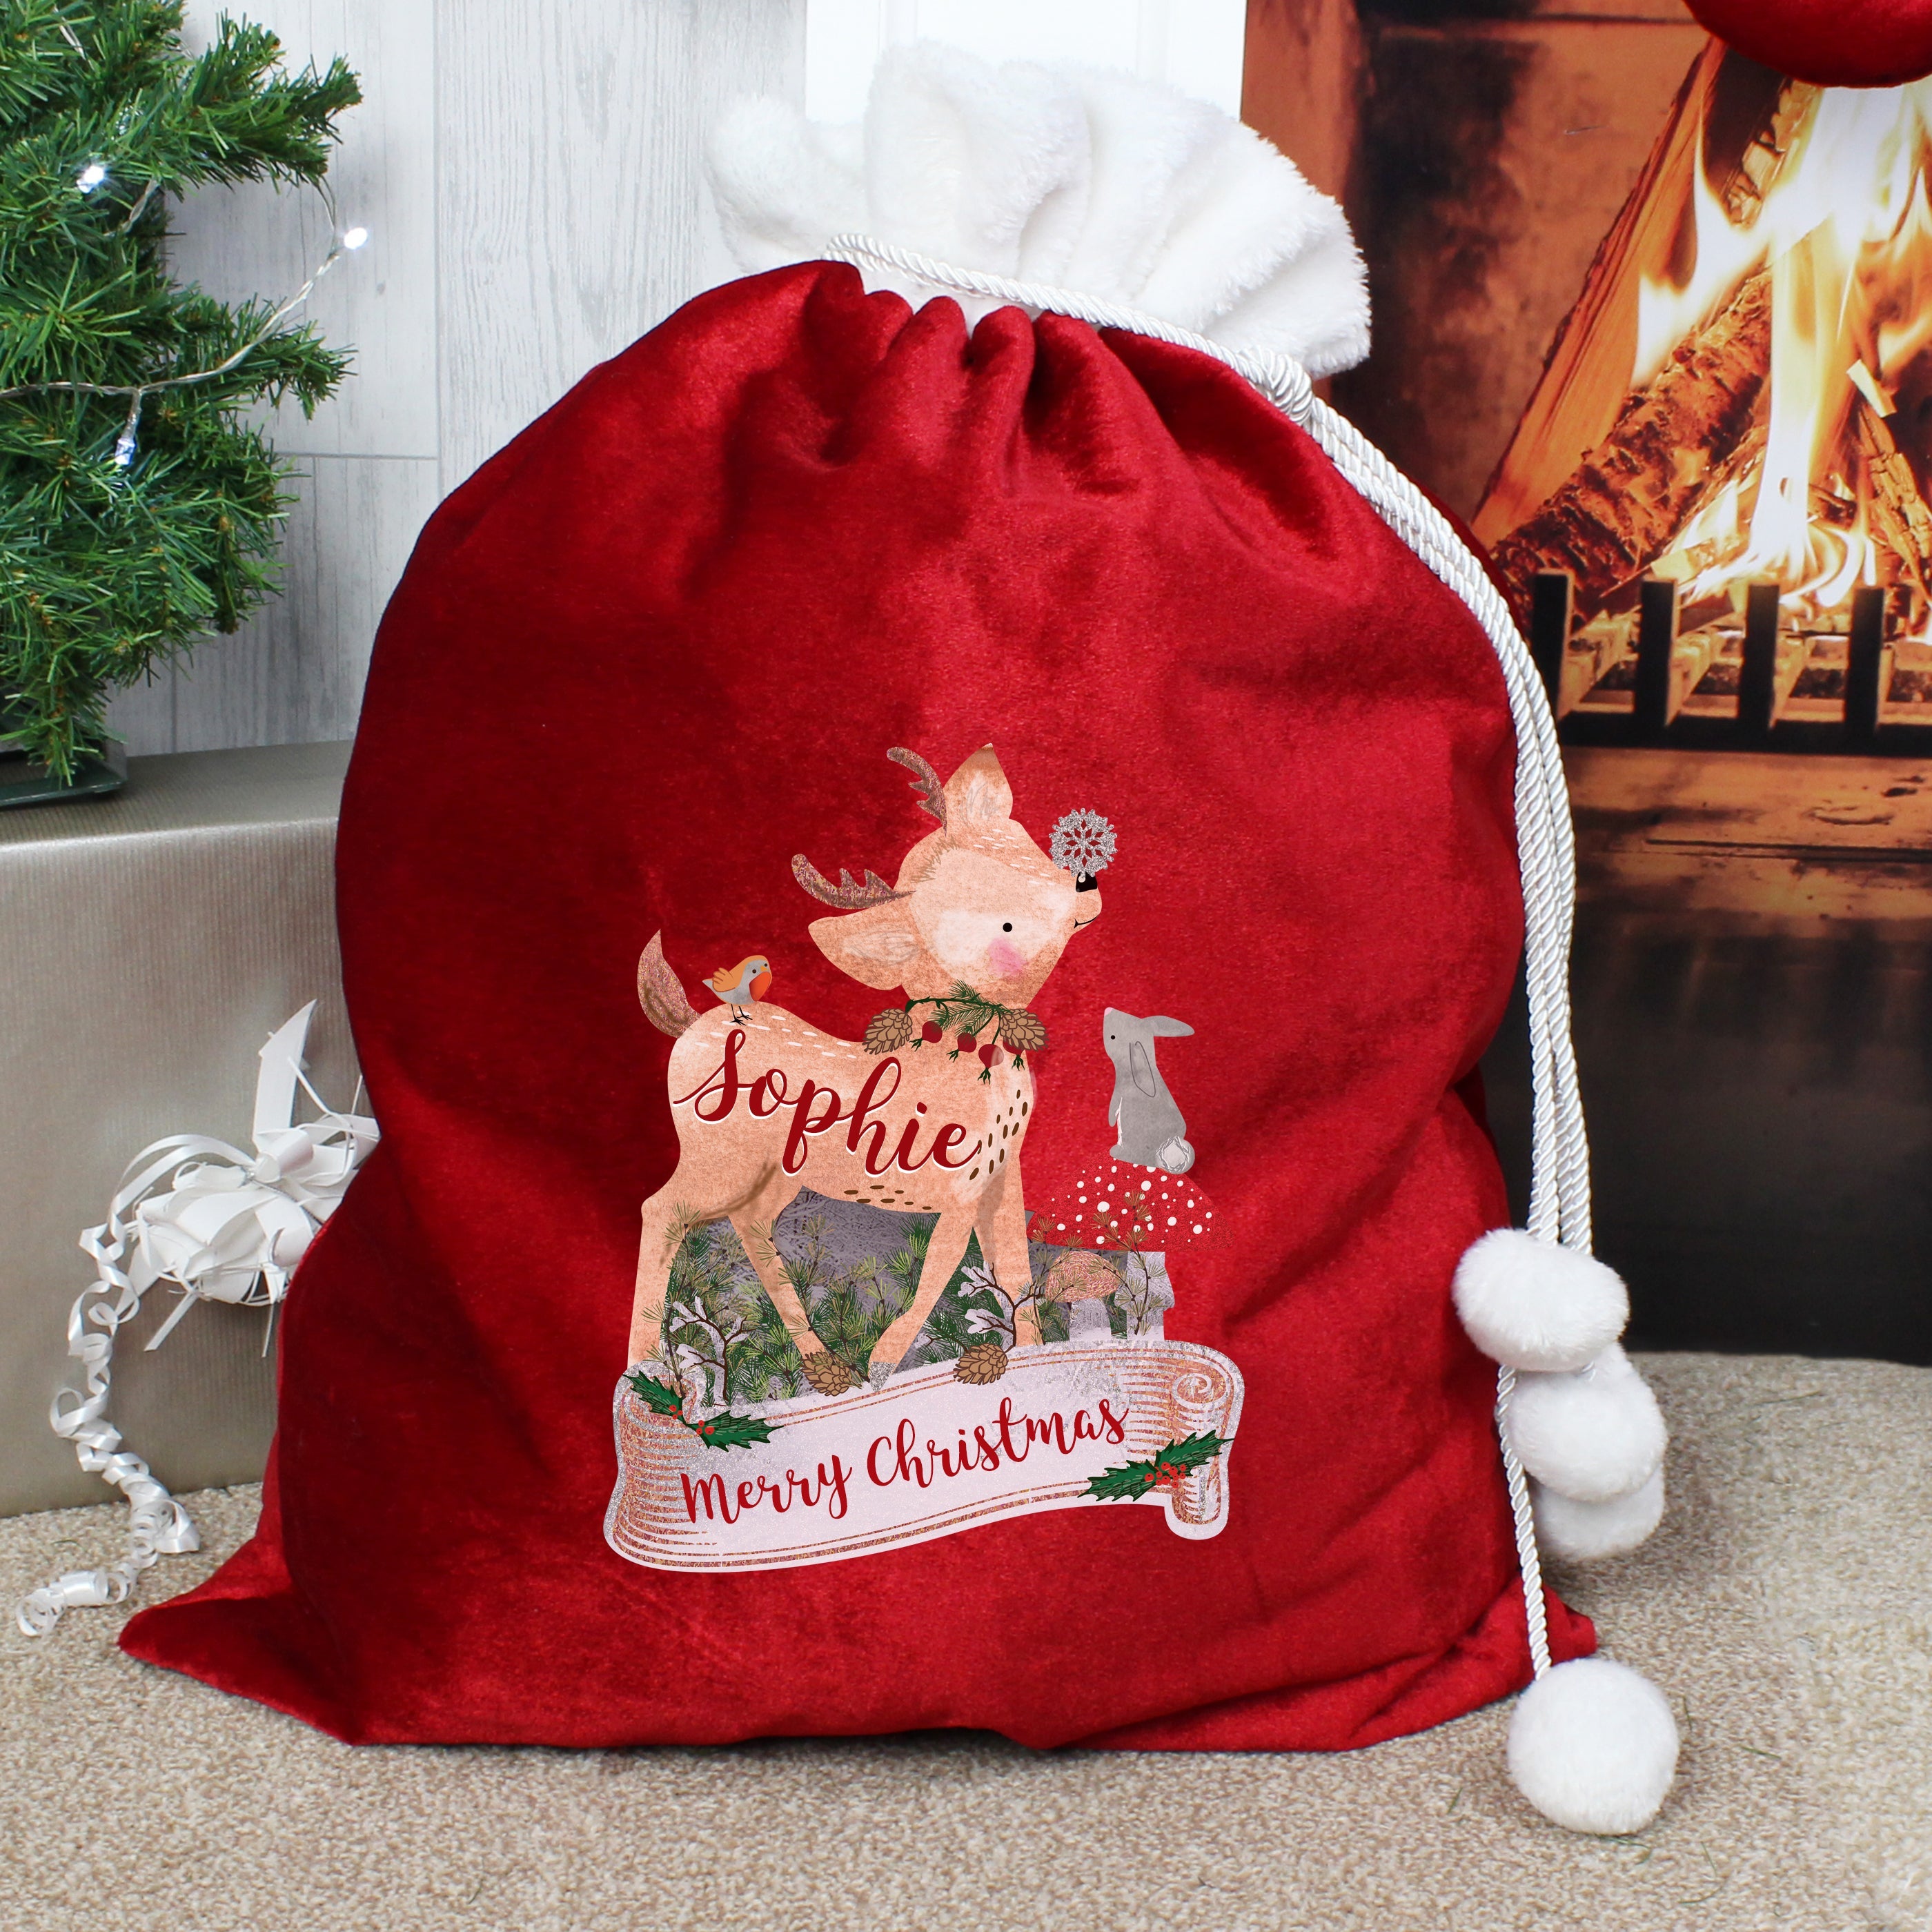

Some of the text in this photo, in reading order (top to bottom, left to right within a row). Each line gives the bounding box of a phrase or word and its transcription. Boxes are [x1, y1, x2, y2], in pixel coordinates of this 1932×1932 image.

[673, 1029, 981, 1176] Sophie
[680, 1397, 1129, 1524] Merry Christmas
